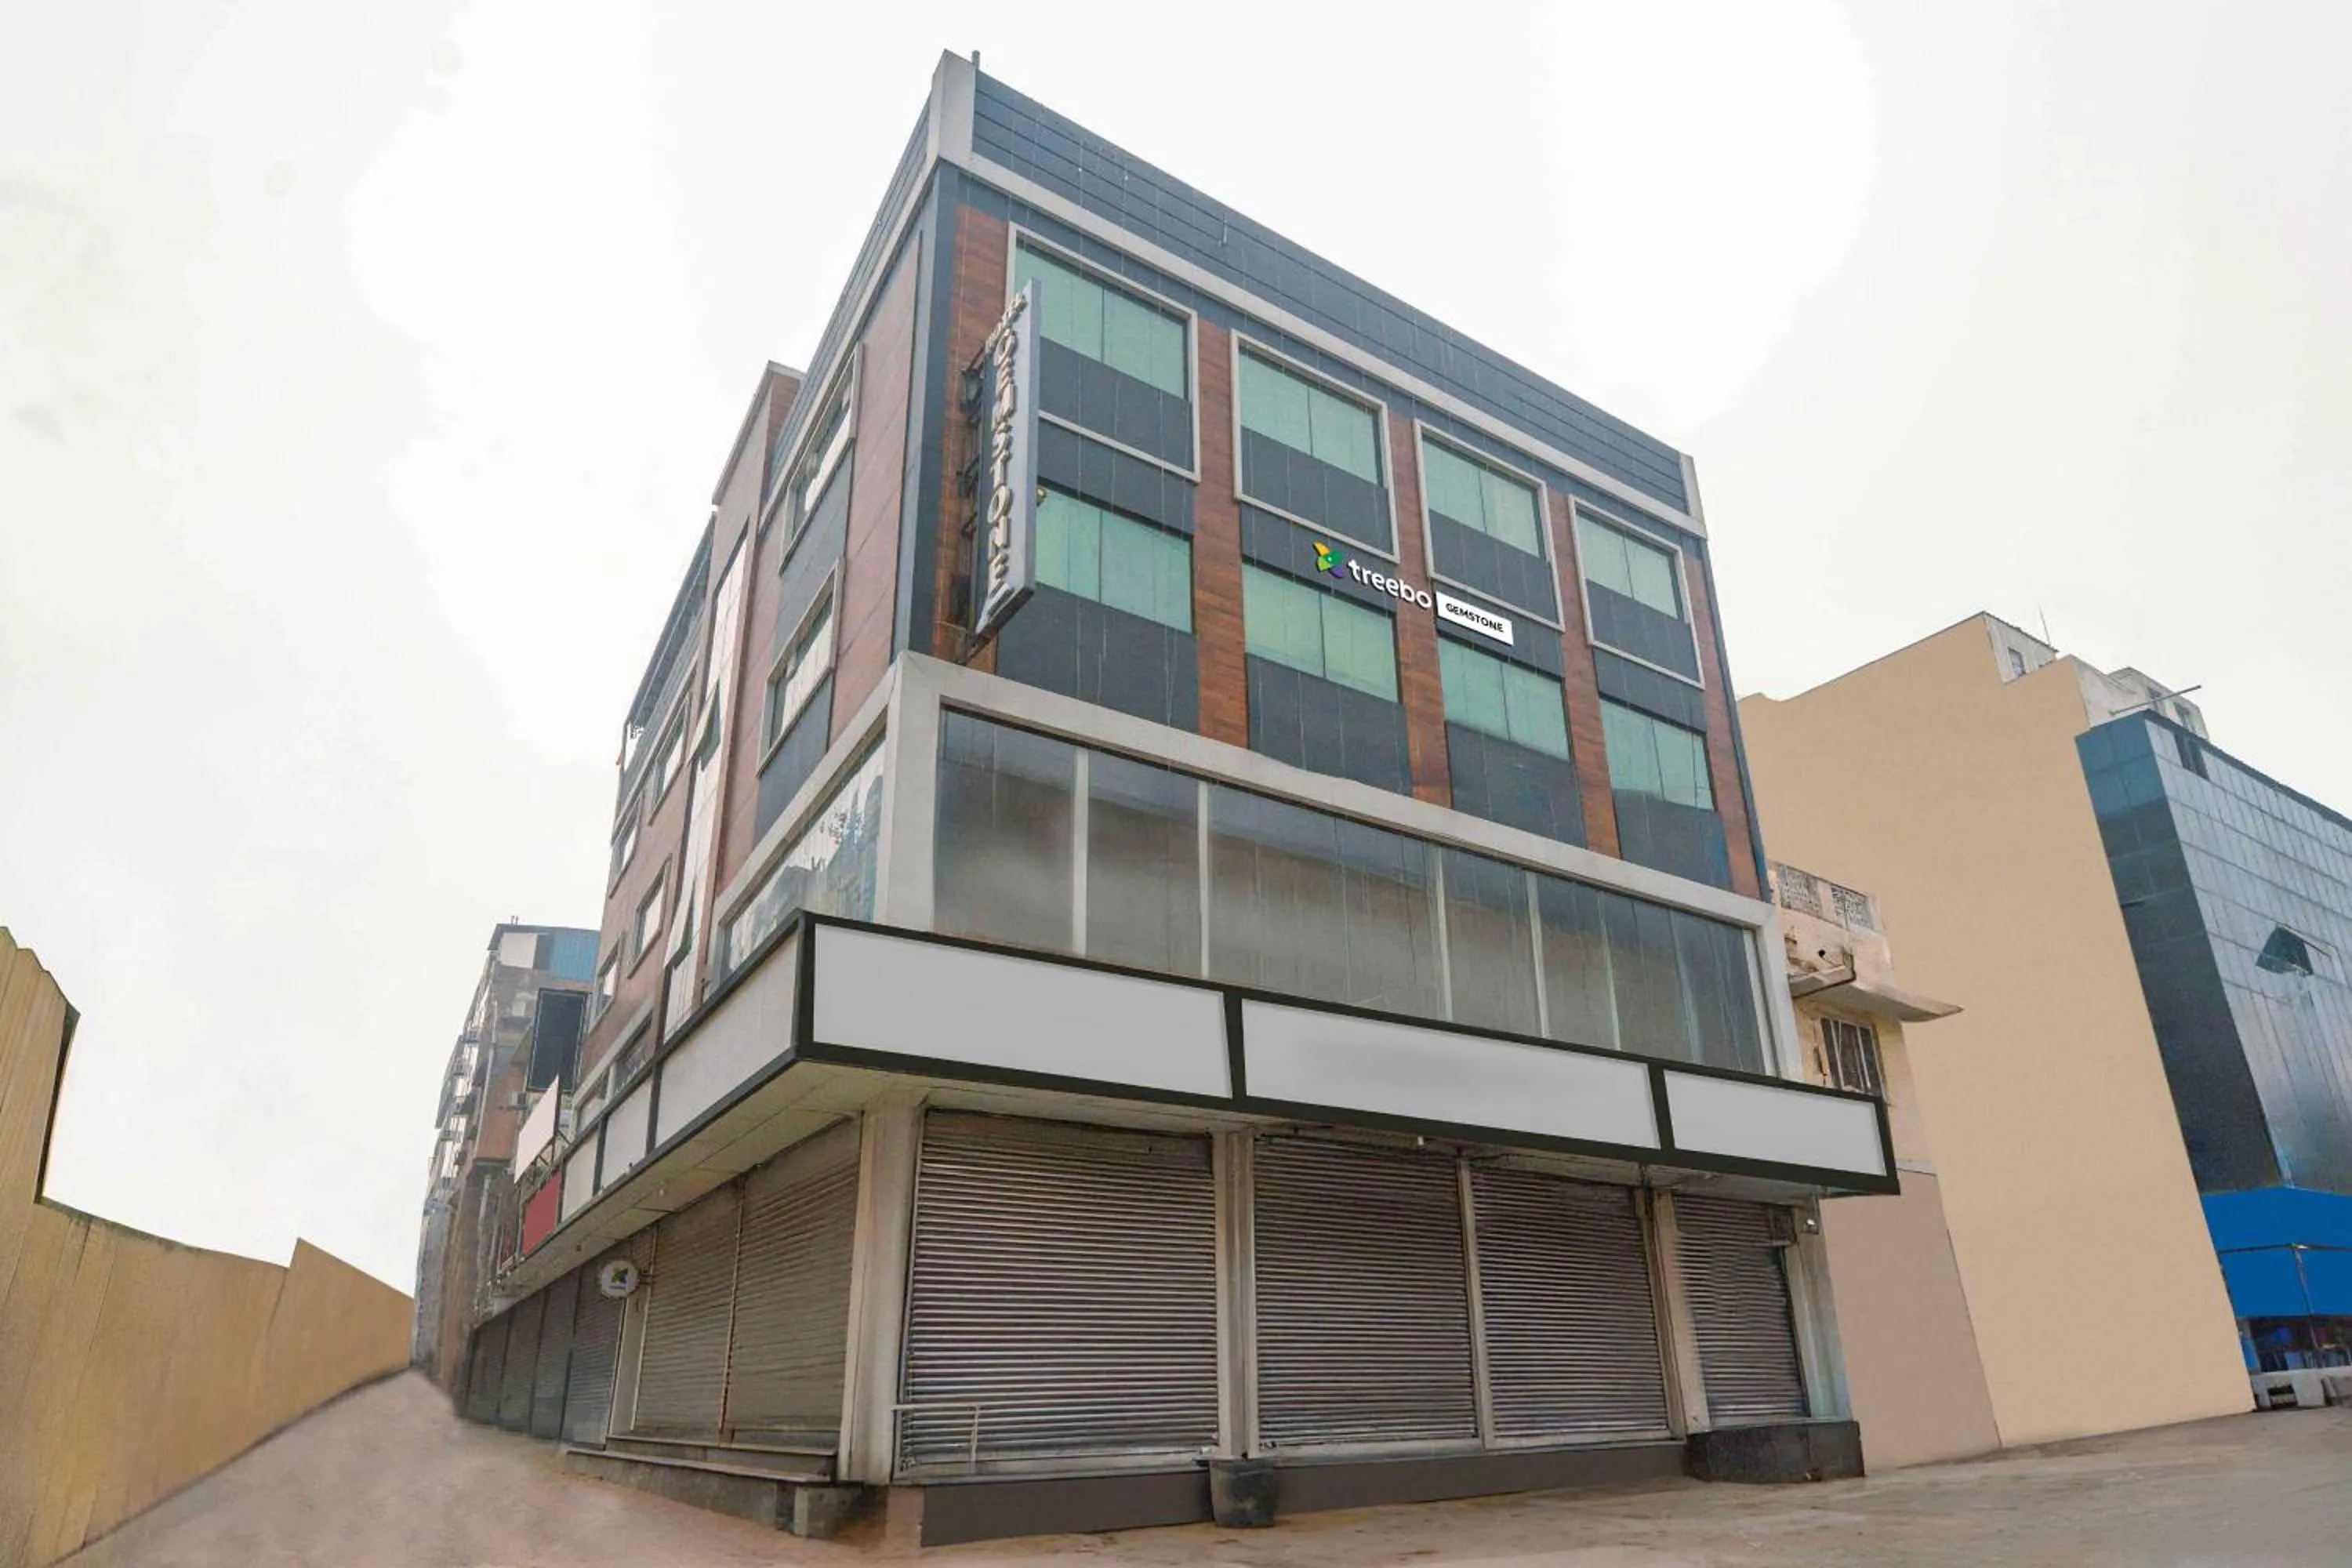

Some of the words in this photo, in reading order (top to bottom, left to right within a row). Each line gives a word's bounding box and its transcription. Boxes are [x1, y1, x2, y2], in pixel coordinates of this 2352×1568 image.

[987, 328, 1018, 599] GEMSTONE
[1347, 559, 1432, 608] treebo
[1445, 602, 1504, 633] GEMSTONE
